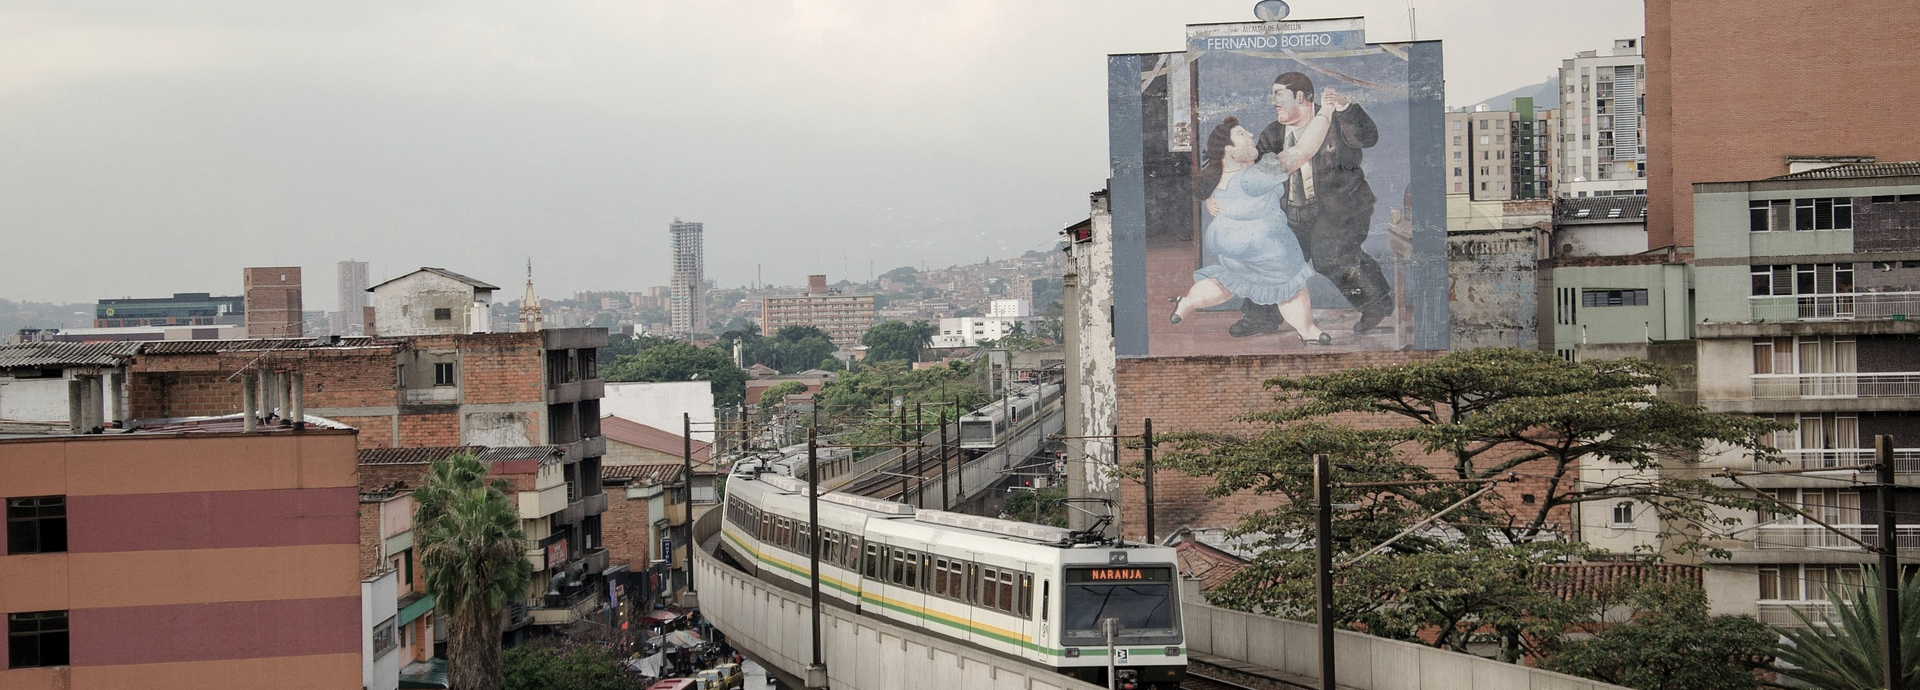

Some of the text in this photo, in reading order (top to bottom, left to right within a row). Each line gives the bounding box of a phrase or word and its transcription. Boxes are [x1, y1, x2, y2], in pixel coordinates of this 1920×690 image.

[1207, 33, 1331, 50] FERNANDO BOTERO
[1092, 569, 1142, 580] NARANJA
